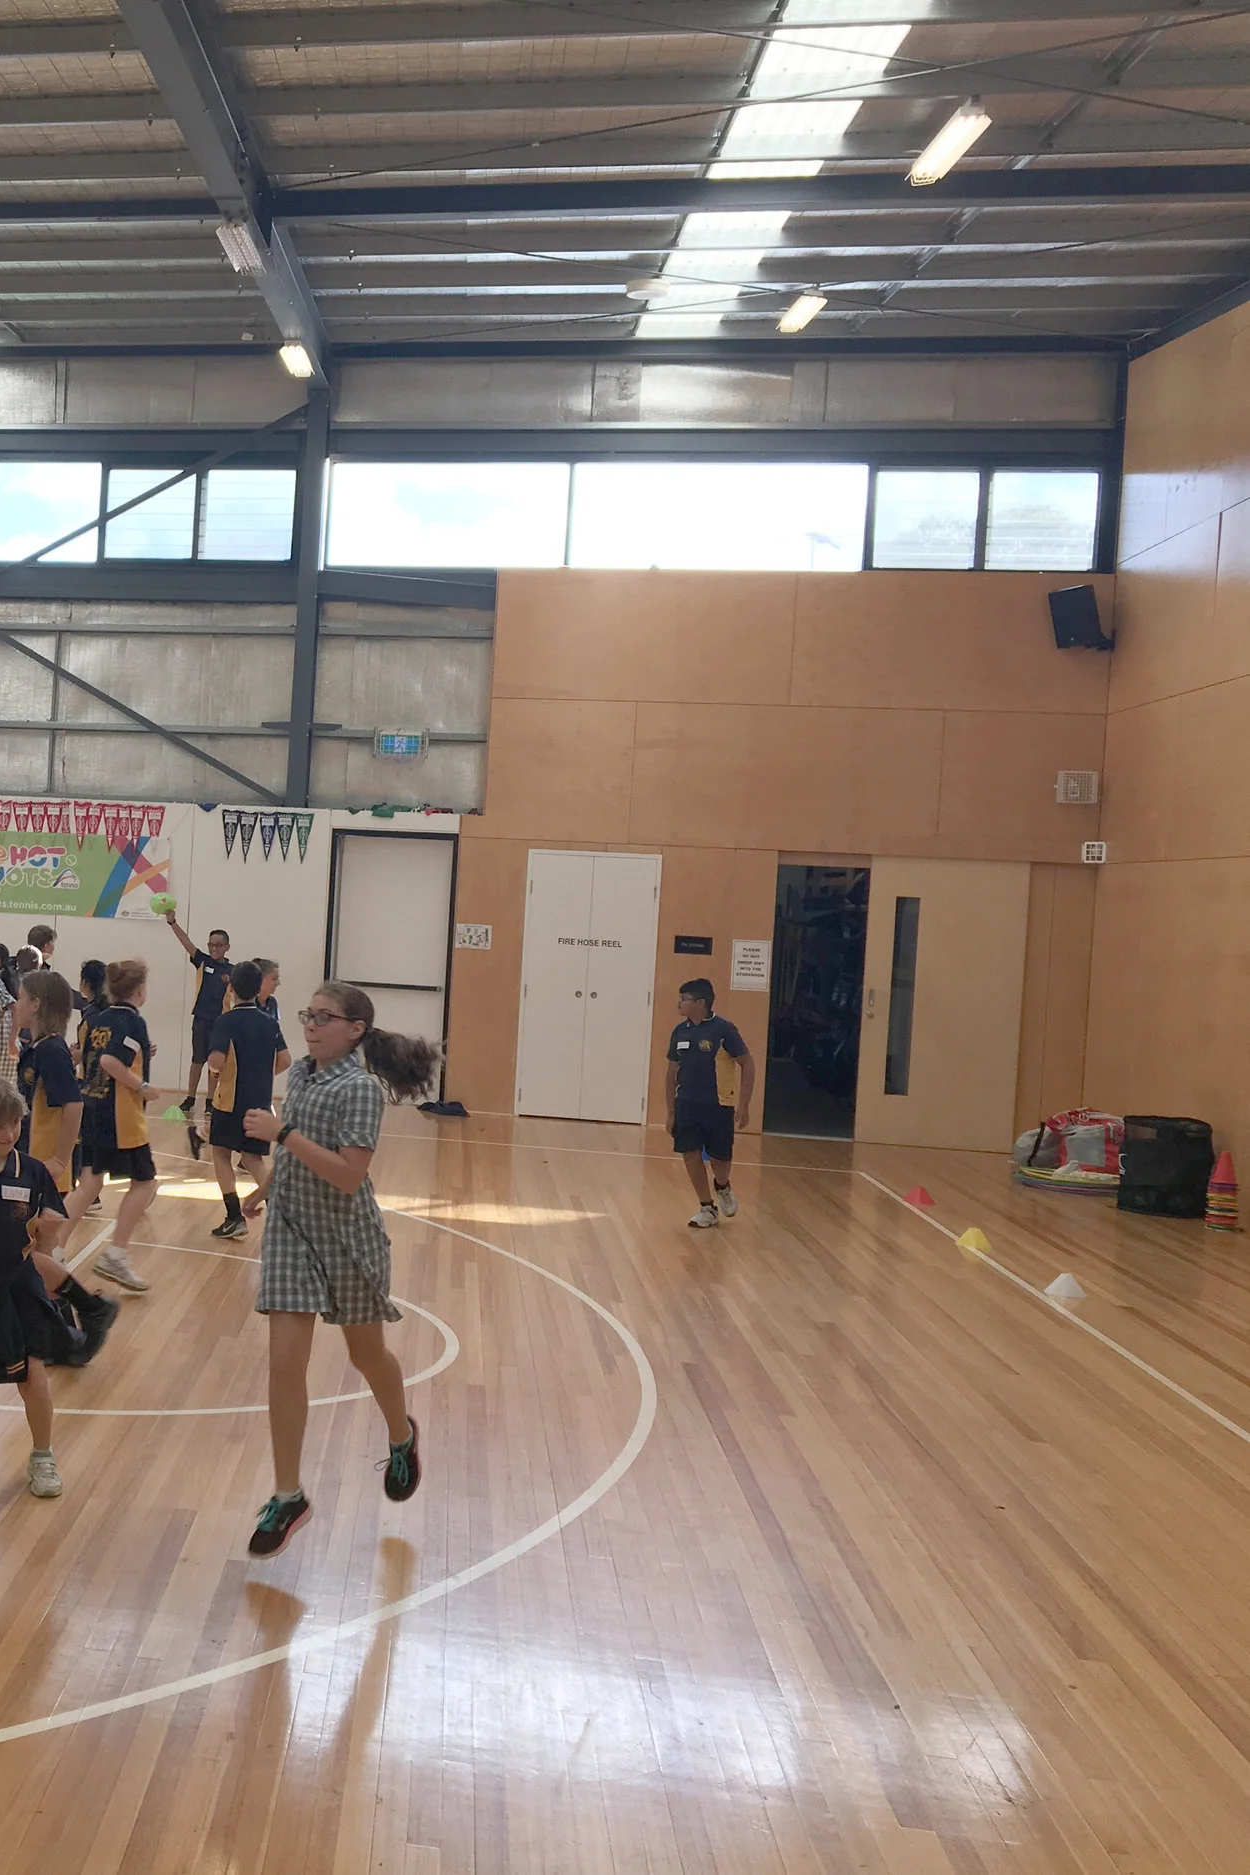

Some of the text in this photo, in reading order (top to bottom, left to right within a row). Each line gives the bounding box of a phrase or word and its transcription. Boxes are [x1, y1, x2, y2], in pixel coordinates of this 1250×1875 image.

[9, 845, 66, 868] HOT
[558, 937, 622, 948] FIRE HOSE REEL
